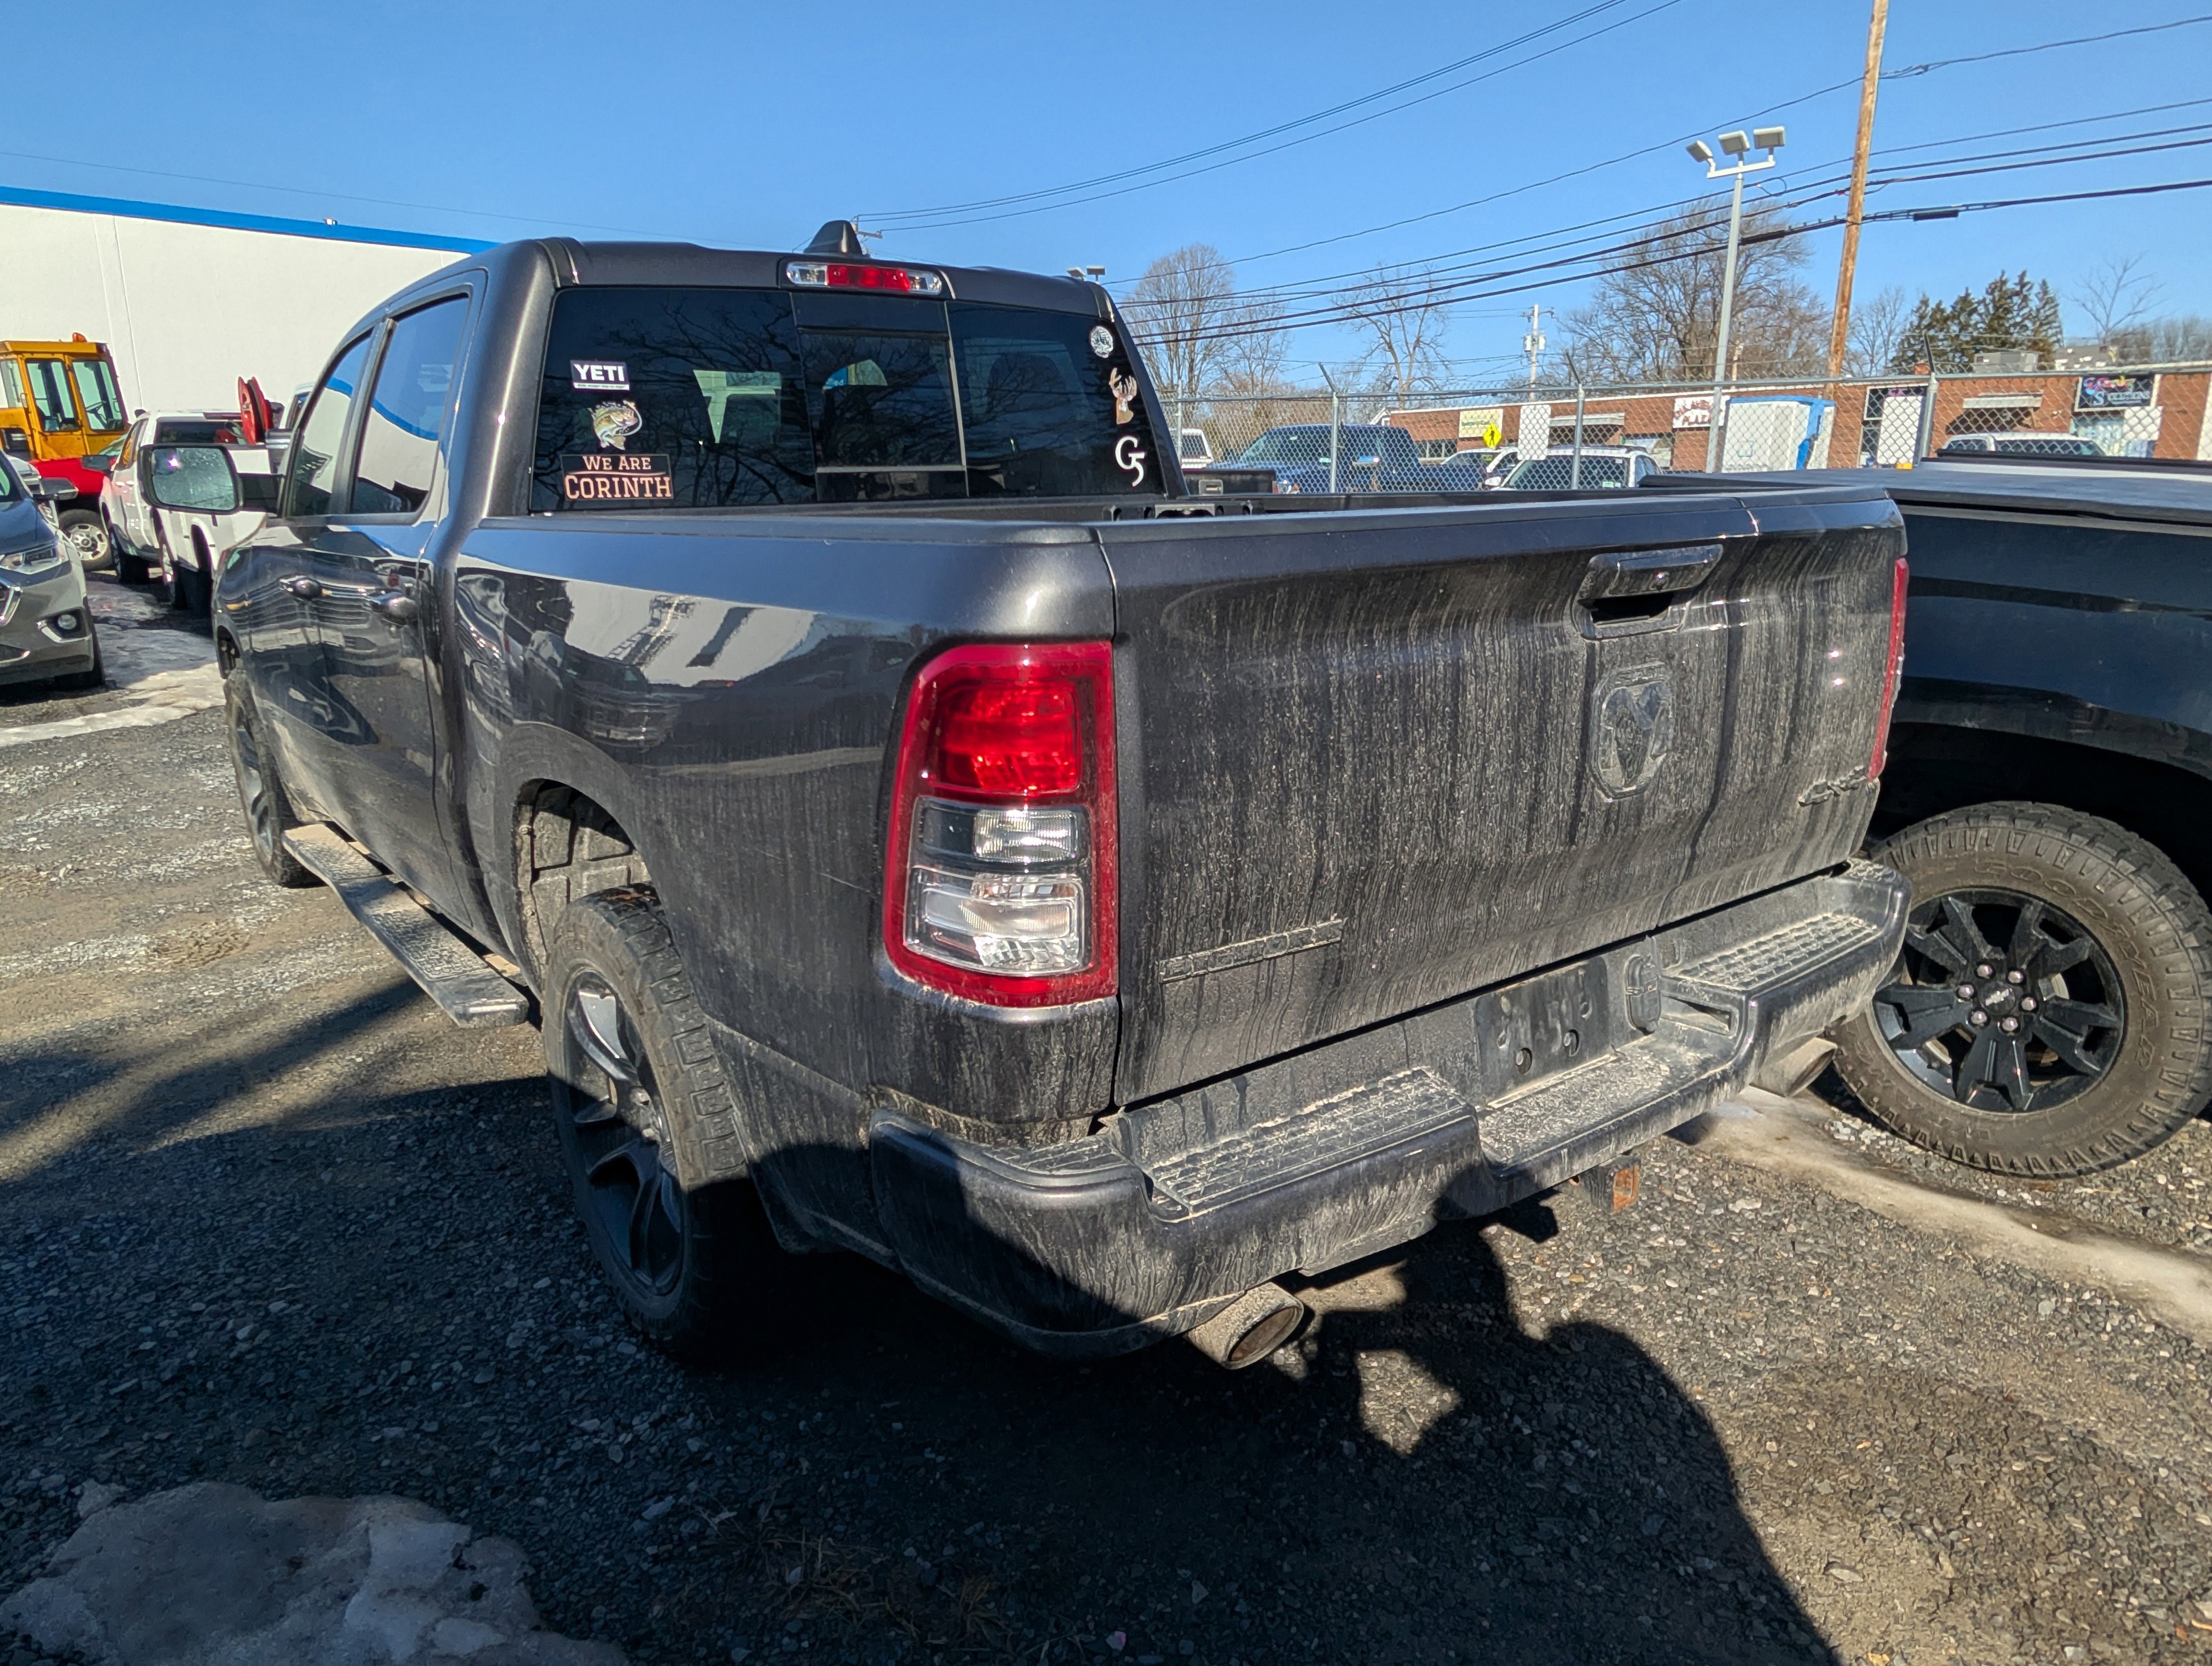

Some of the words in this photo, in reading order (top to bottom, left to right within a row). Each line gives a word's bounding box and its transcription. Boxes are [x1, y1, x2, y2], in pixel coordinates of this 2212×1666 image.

[573, 364, 625, 381] YETI
[582, 456, 612, 470] WE
[618, 456, 652, 470] ARE
[1115, 436, 1145, 487] G5
[565, 475, 672, 499] CORINTH
